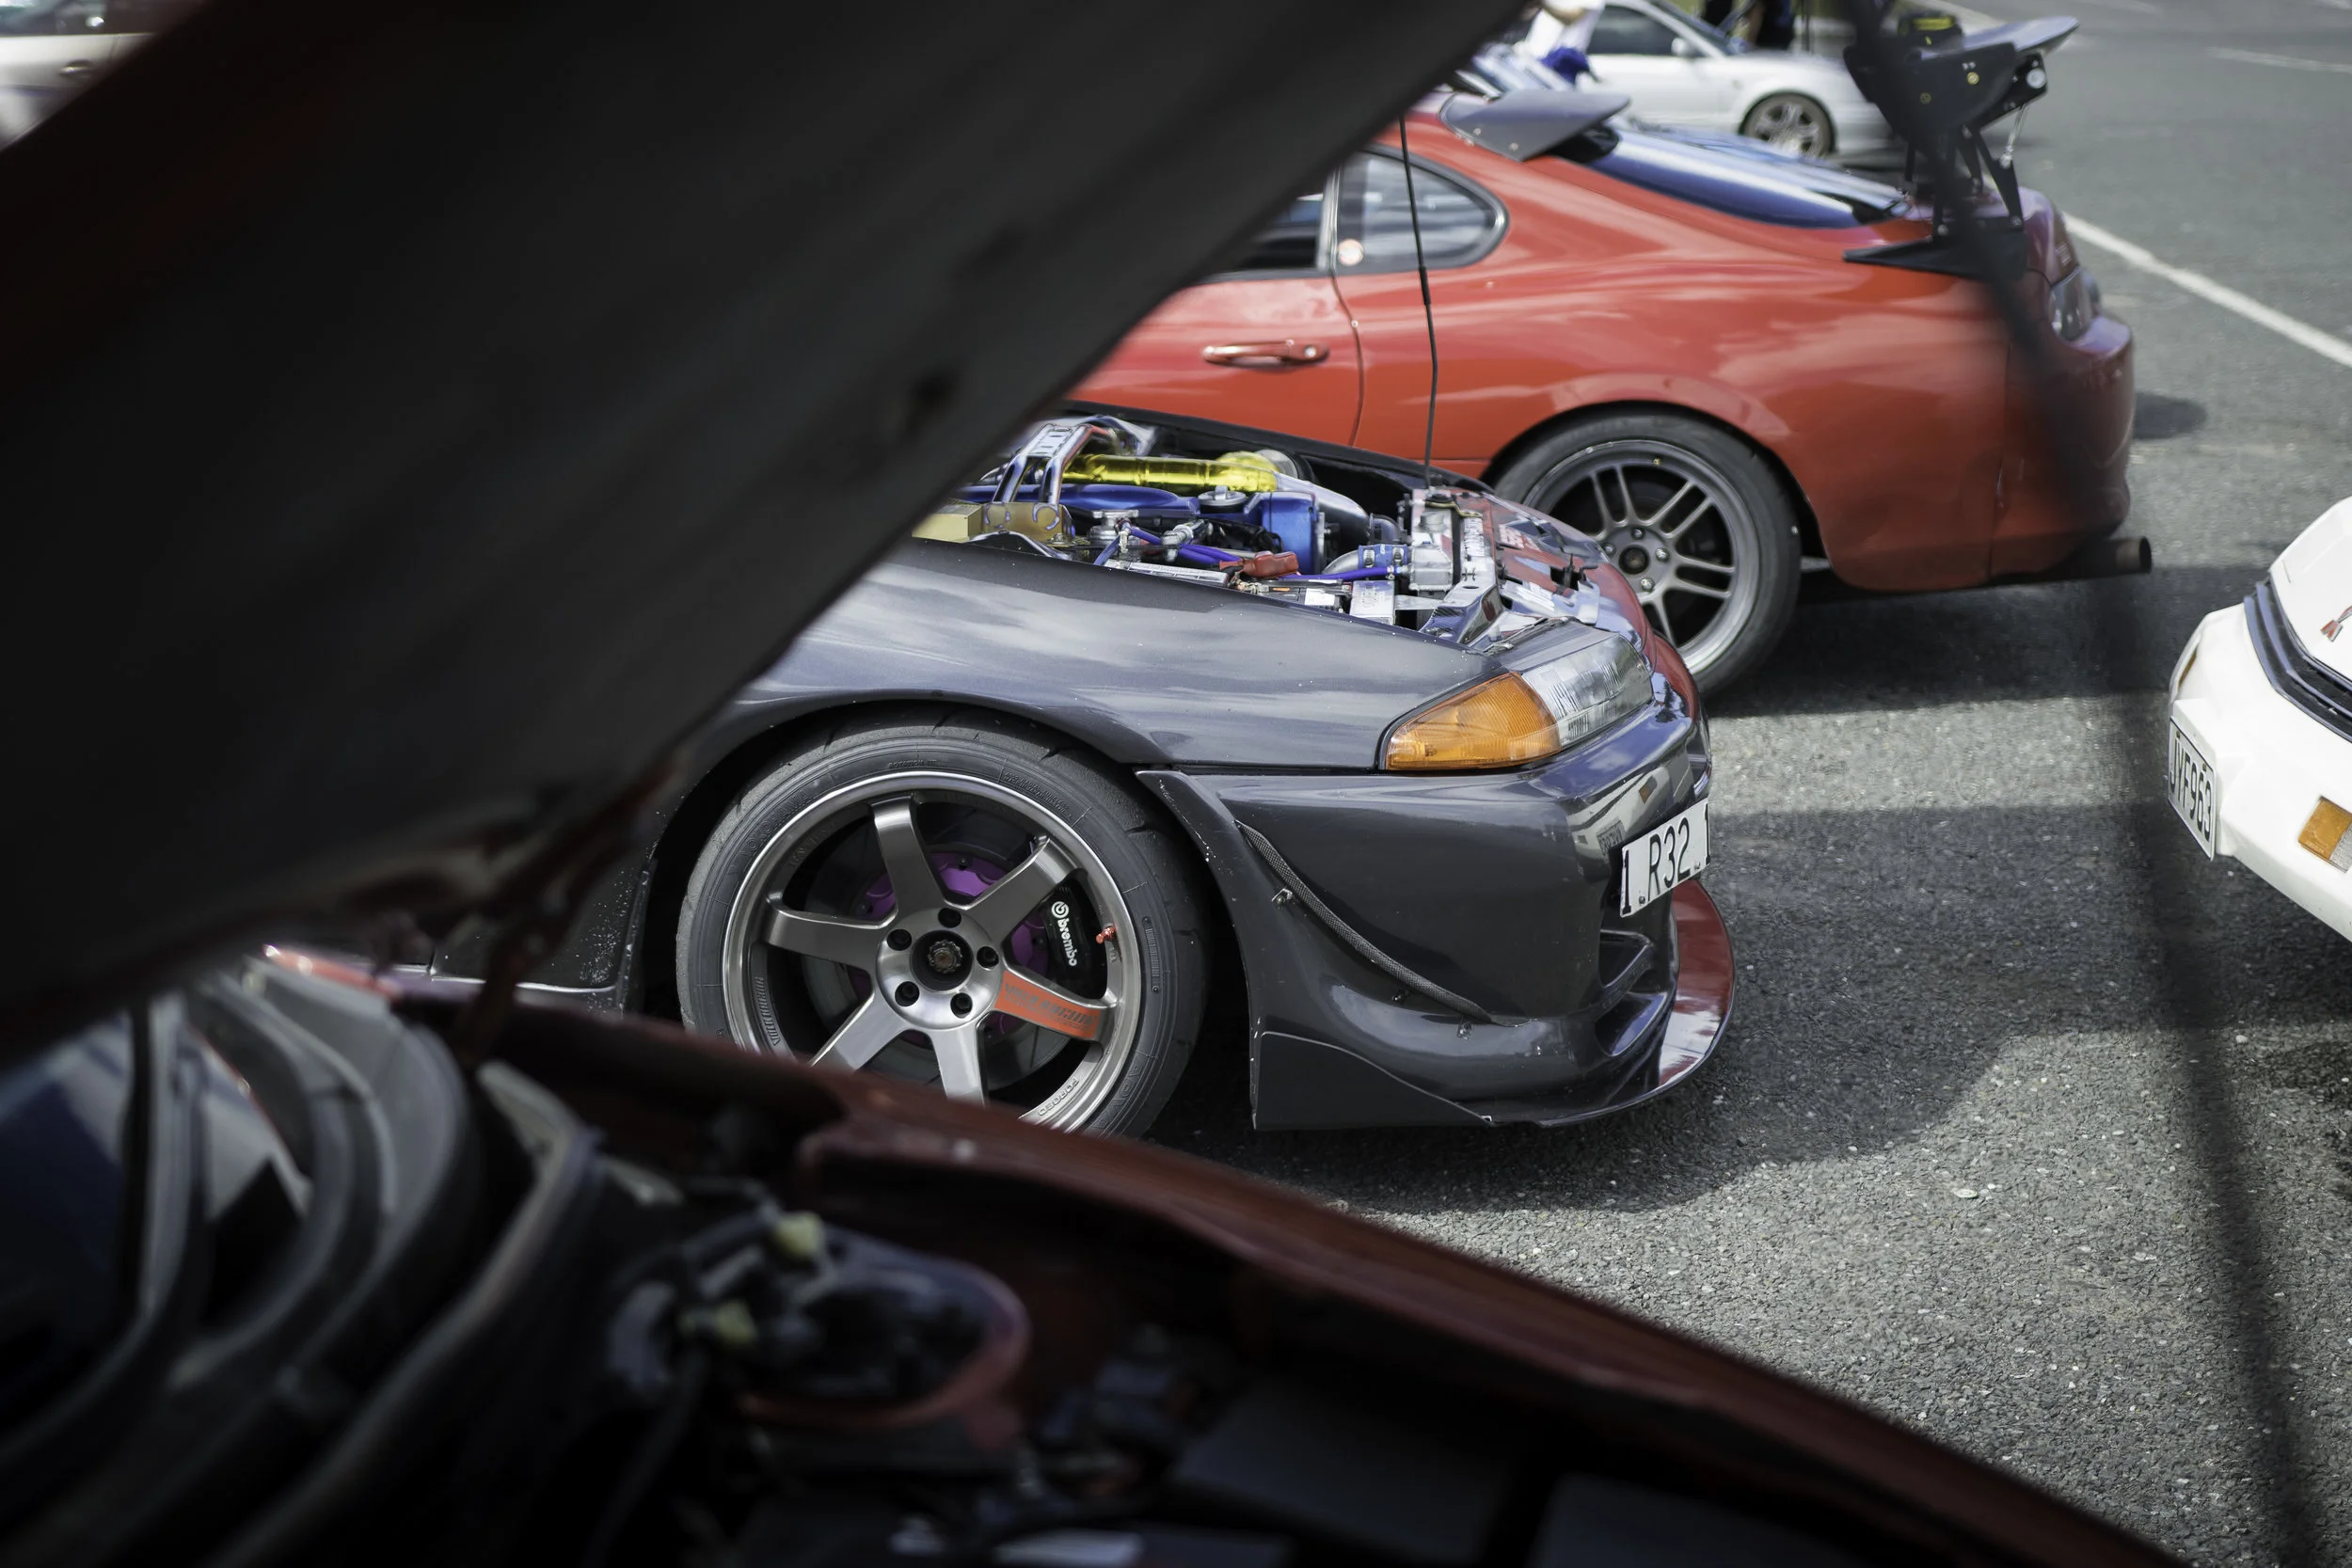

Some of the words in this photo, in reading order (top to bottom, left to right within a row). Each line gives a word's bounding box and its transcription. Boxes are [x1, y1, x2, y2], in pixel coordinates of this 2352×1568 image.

[2169, 738, 2211, 842] JYF963
[1648, 817, 1691, 901] R32
[1057, 917, 1078, 967] brembo
[1038, 1077, 1080, 1117] FORGED
